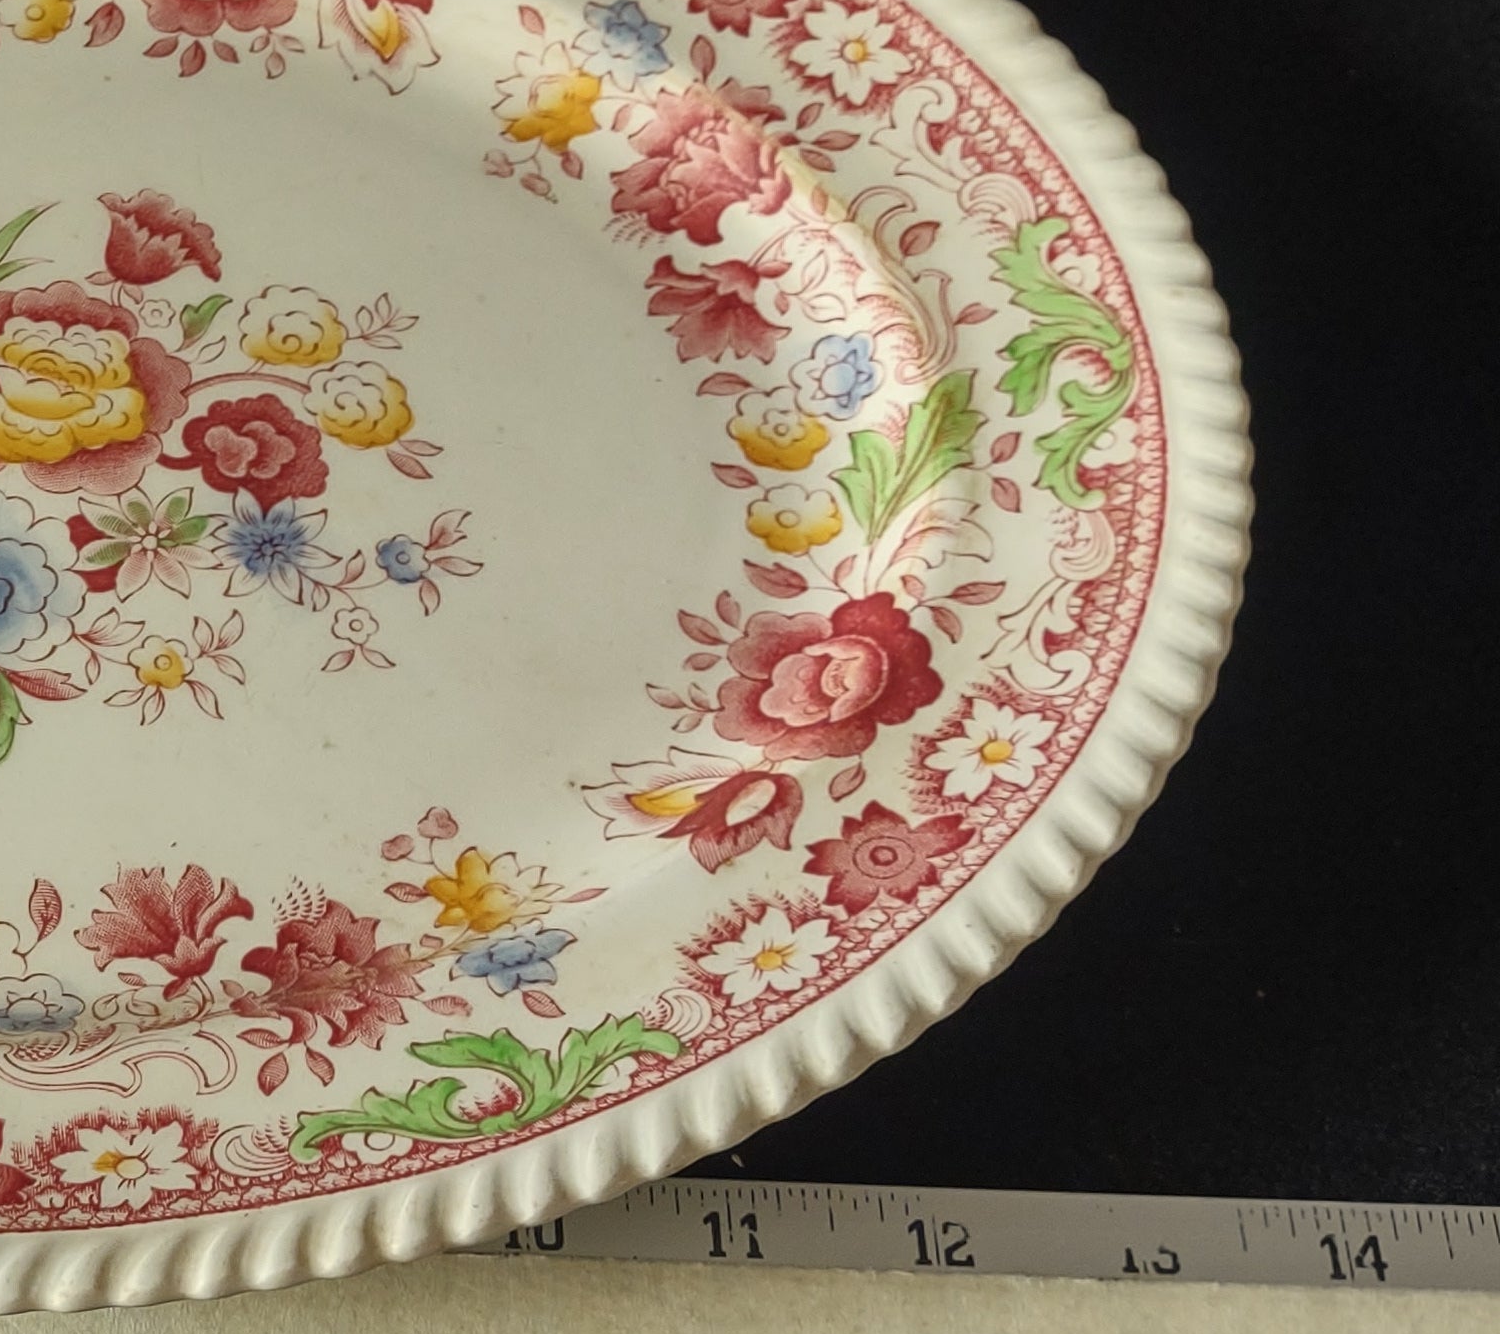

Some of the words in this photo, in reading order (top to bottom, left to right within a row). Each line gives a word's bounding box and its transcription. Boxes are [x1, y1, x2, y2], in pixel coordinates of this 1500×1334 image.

[702, 1211, 764, 1259] 11
[908, 1218, 975, 1267] 12
[1319, 1233, 1389, 1282] 14
